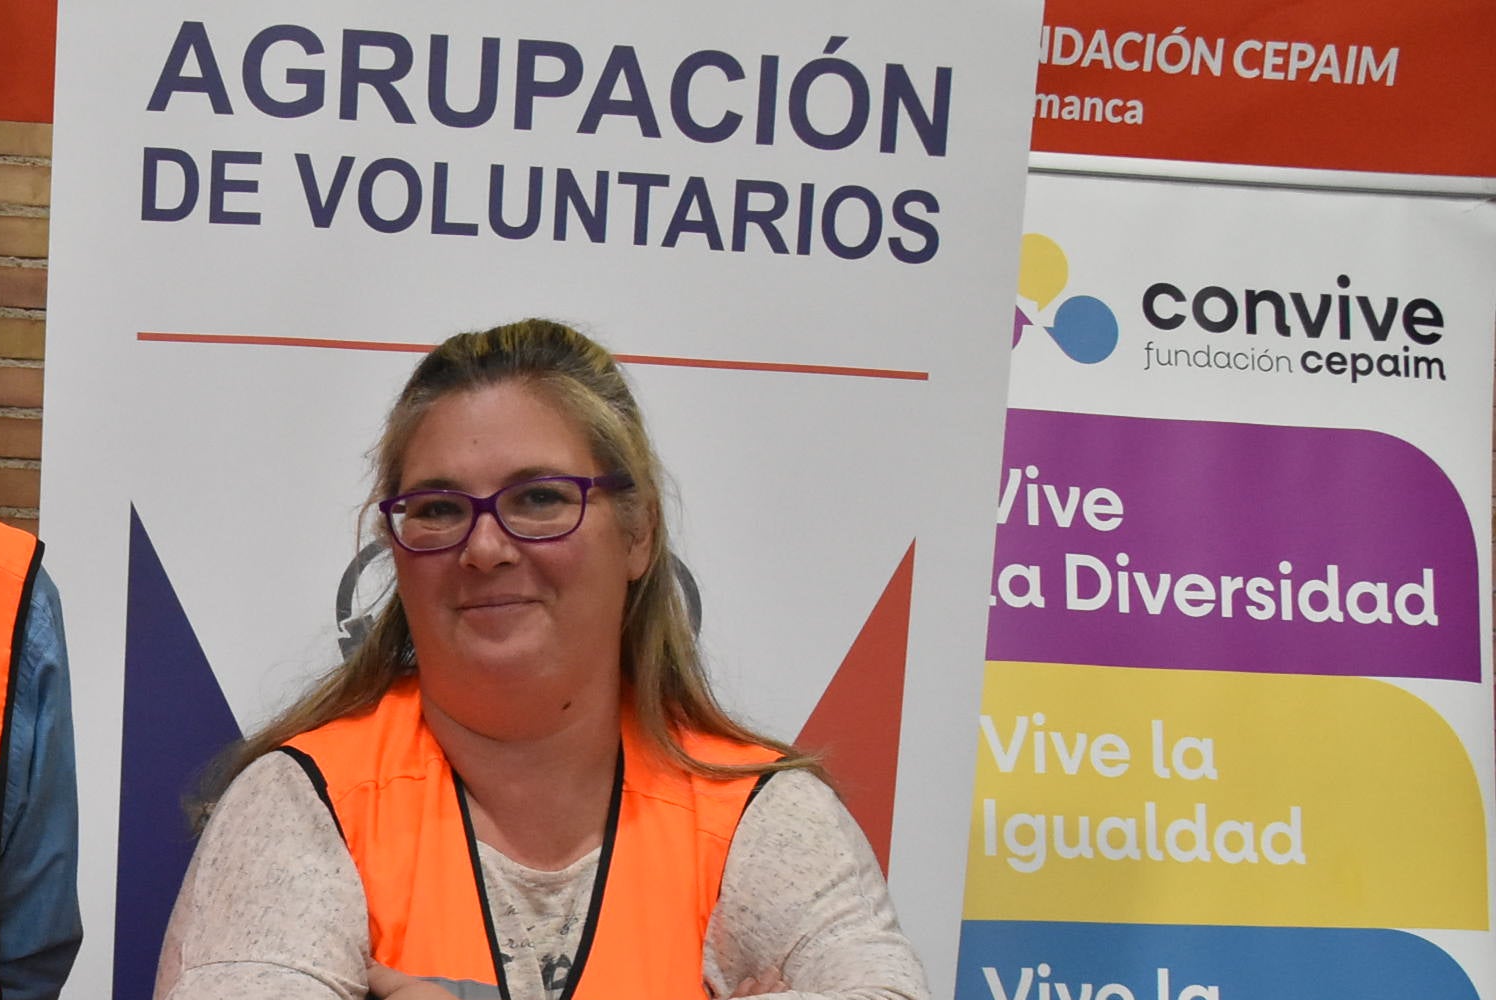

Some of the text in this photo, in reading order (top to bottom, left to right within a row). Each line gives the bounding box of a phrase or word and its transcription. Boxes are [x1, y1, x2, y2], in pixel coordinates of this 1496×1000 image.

[146, 20, 953, 157] AGRUPACIÓN
[1233, 40, 1399, 87] CEPAIM
[141, 147, 941, 264] DE VOLUNTARIOS
[1142, 274, 1444, 346] convive
[1144, 342, 1447, 384] fundación cepaim
[989, 553, 1439, 627] a Diversidad
[980, 712, 1218, 780] Vive la
[983, 798, 1307, 873] Igualdad
